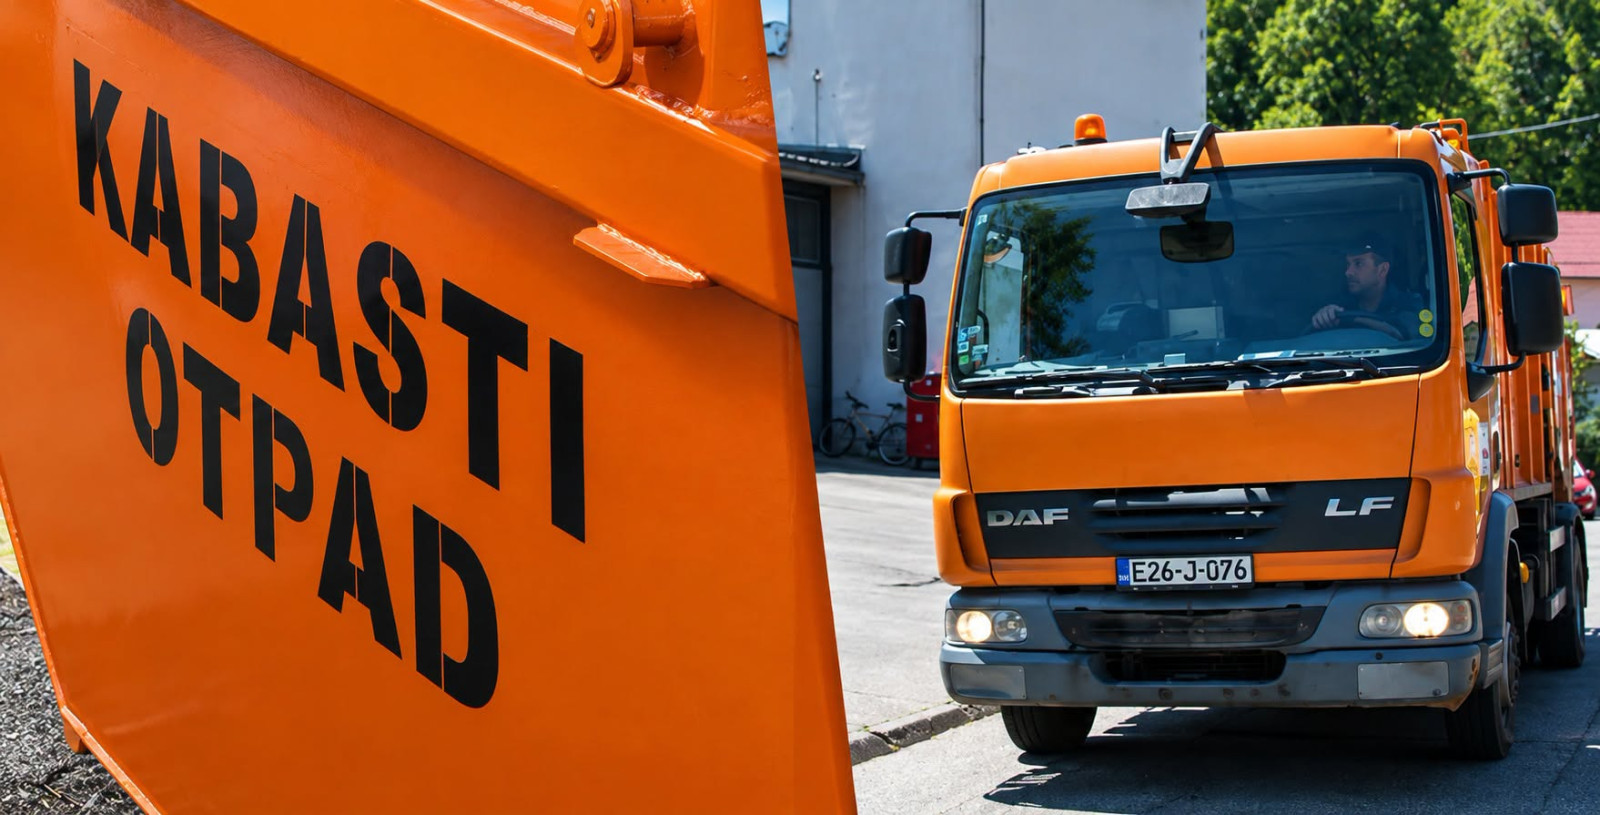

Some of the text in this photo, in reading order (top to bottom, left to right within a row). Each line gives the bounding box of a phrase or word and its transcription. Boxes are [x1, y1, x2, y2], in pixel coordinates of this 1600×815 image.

[73, 59, 585, 543] KABASTI
[125, 308, 499, 708] OTPAD
[987, 508, 1069, 527] DAF
[1324, 496, 1395, 517] LF
[1132, 559, 1248, 583] E26-J-076
